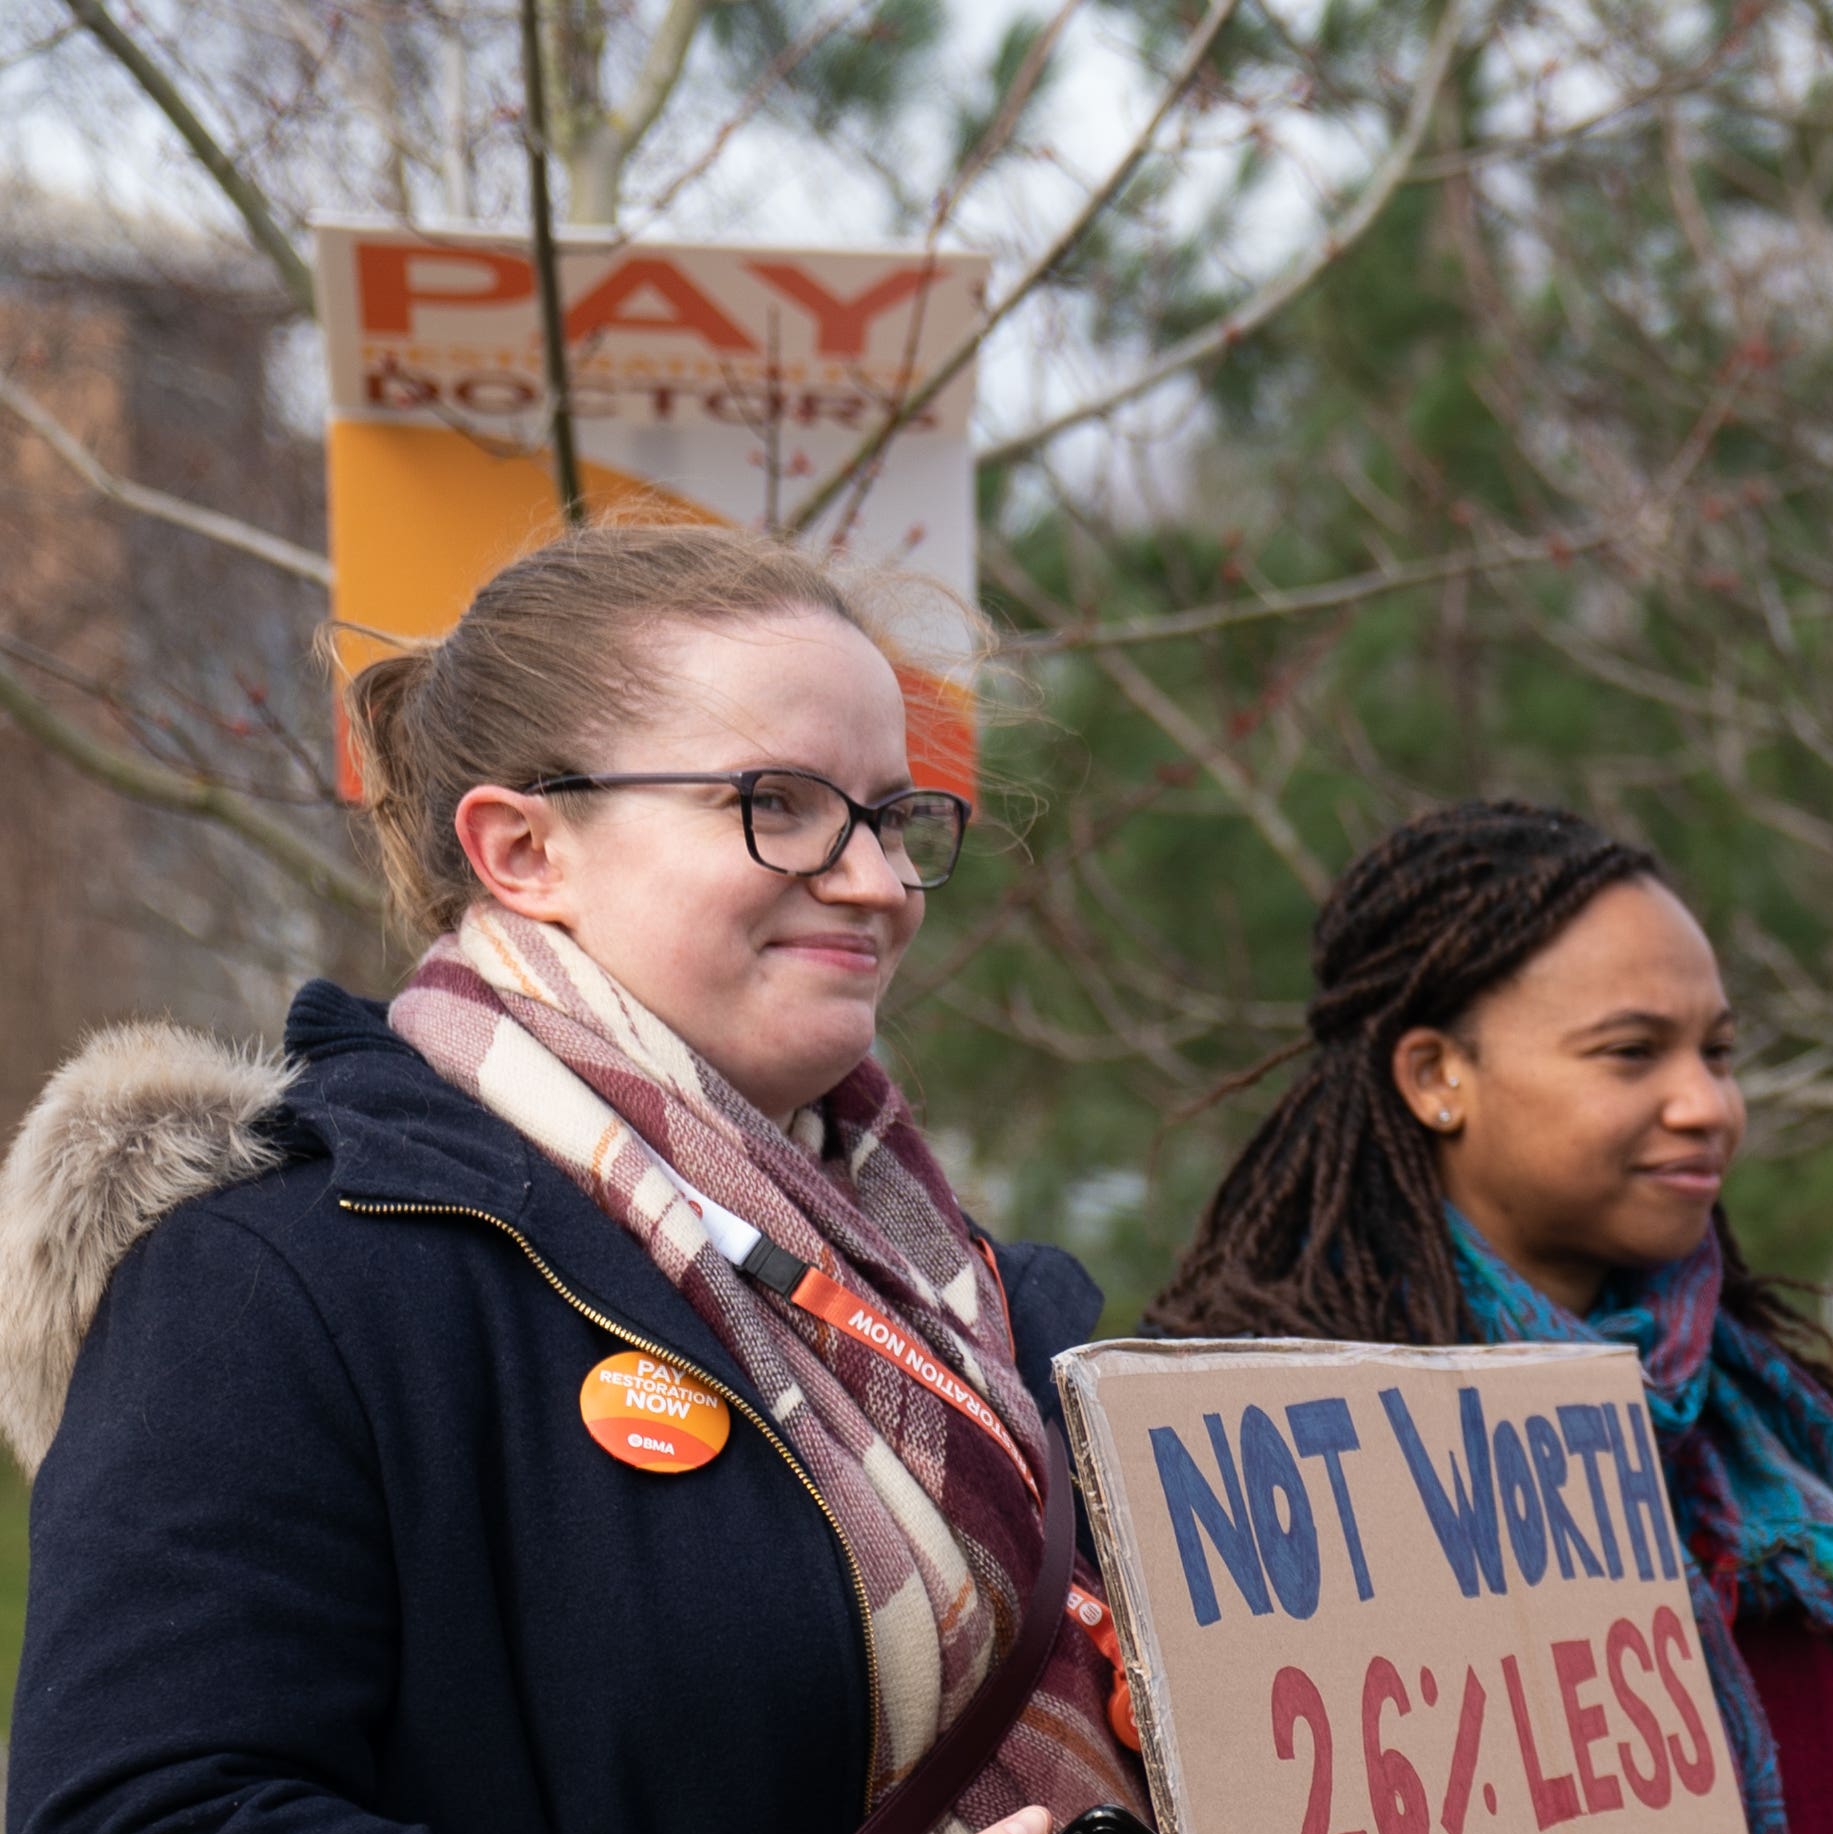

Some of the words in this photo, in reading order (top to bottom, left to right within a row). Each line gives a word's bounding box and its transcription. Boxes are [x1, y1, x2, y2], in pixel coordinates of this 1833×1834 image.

[356, 242, 952, 358] PAY
[848, 1309, 905, 1357] NOW
[599, 1370, 718, 1408] RESTORATION
[638, 1359, 687, 1385] PAY
[625, 1388, 691, 1419] NOW
[643, 1437, 675, 1455] BMA
[1148, 1397, 1375, 1627] NOT
[1378, 1386, 1680, 1597] WORTH
[1501, 1605, 1717, 1832] LESS
